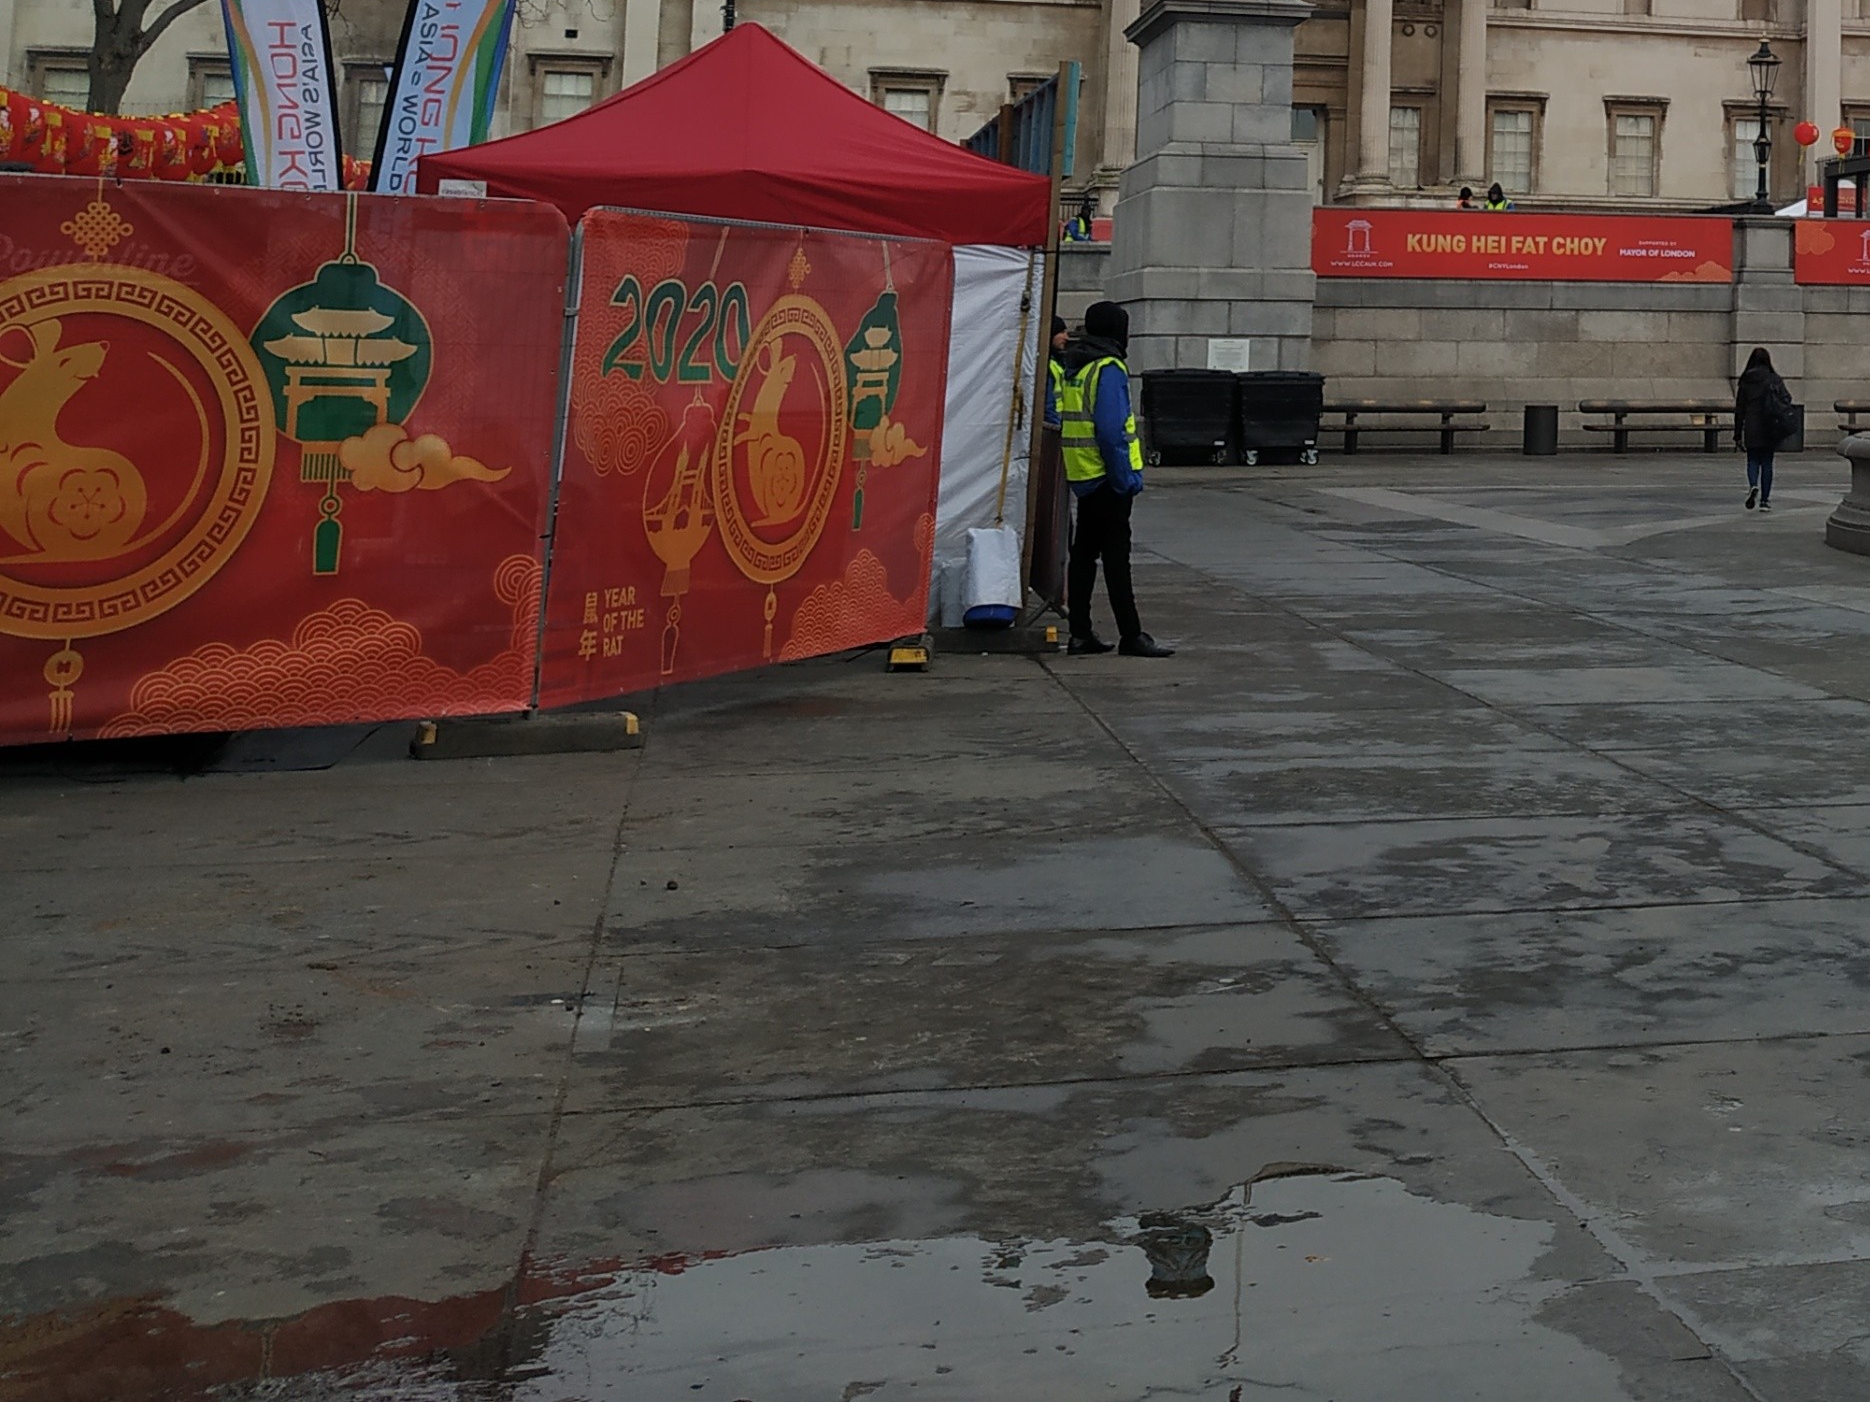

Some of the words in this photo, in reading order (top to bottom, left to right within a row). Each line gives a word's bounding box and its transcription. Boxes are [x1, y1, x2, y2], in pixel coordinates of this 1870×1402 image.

[389, 93, 418, 192] WORLD
[1407, 233, 1466, 253] KUNG
[1472, 235, 1506, 254] HEI
[1511, 236, 1549, 255] FAT
[1552, 237, 1607, 256] CHOY
[1620, 249, 1647, 257] MAYOR
[1648, 249, 1659, 258] OF
[1661, 250, 1696, 258] LONDON
[601, 273, 751, 385] 2020
[604, 586, 636, 609] YEAR
[603, 612, 619, 634] OF
[620, 609, 645, 631] THE
[603, 635, 624, 658] RAT
